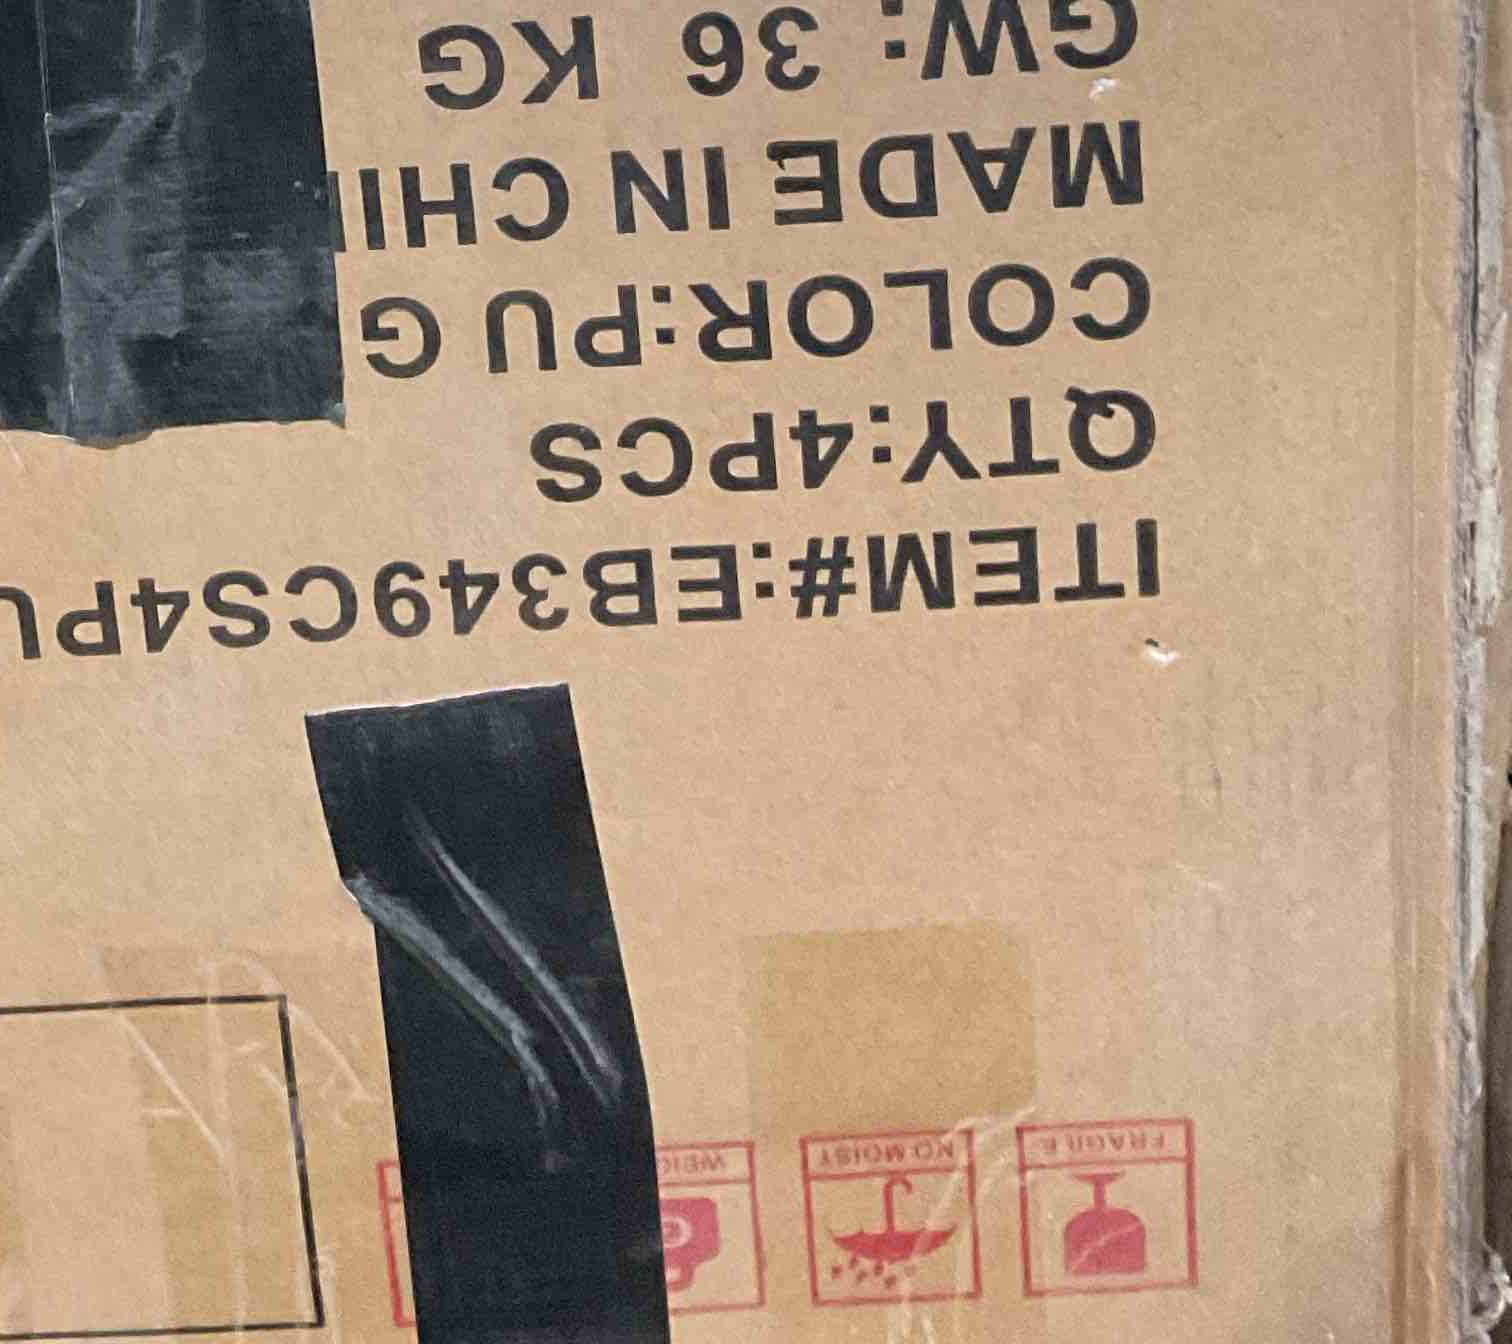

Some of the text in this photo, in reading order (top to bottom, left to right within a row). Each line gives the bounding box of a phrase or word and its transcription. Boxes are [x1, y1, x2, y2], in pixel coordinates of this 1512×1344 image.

[418, 15, 599, 110] KG
[682, 6, 820, 97] 36
[611, 146, 730, 234] IN
[766, 120, 1144, 226] MADE
[486, 257, 1151, 374] COLOR:PU
[530, 387, 1156, 503] QTY:4PCS
